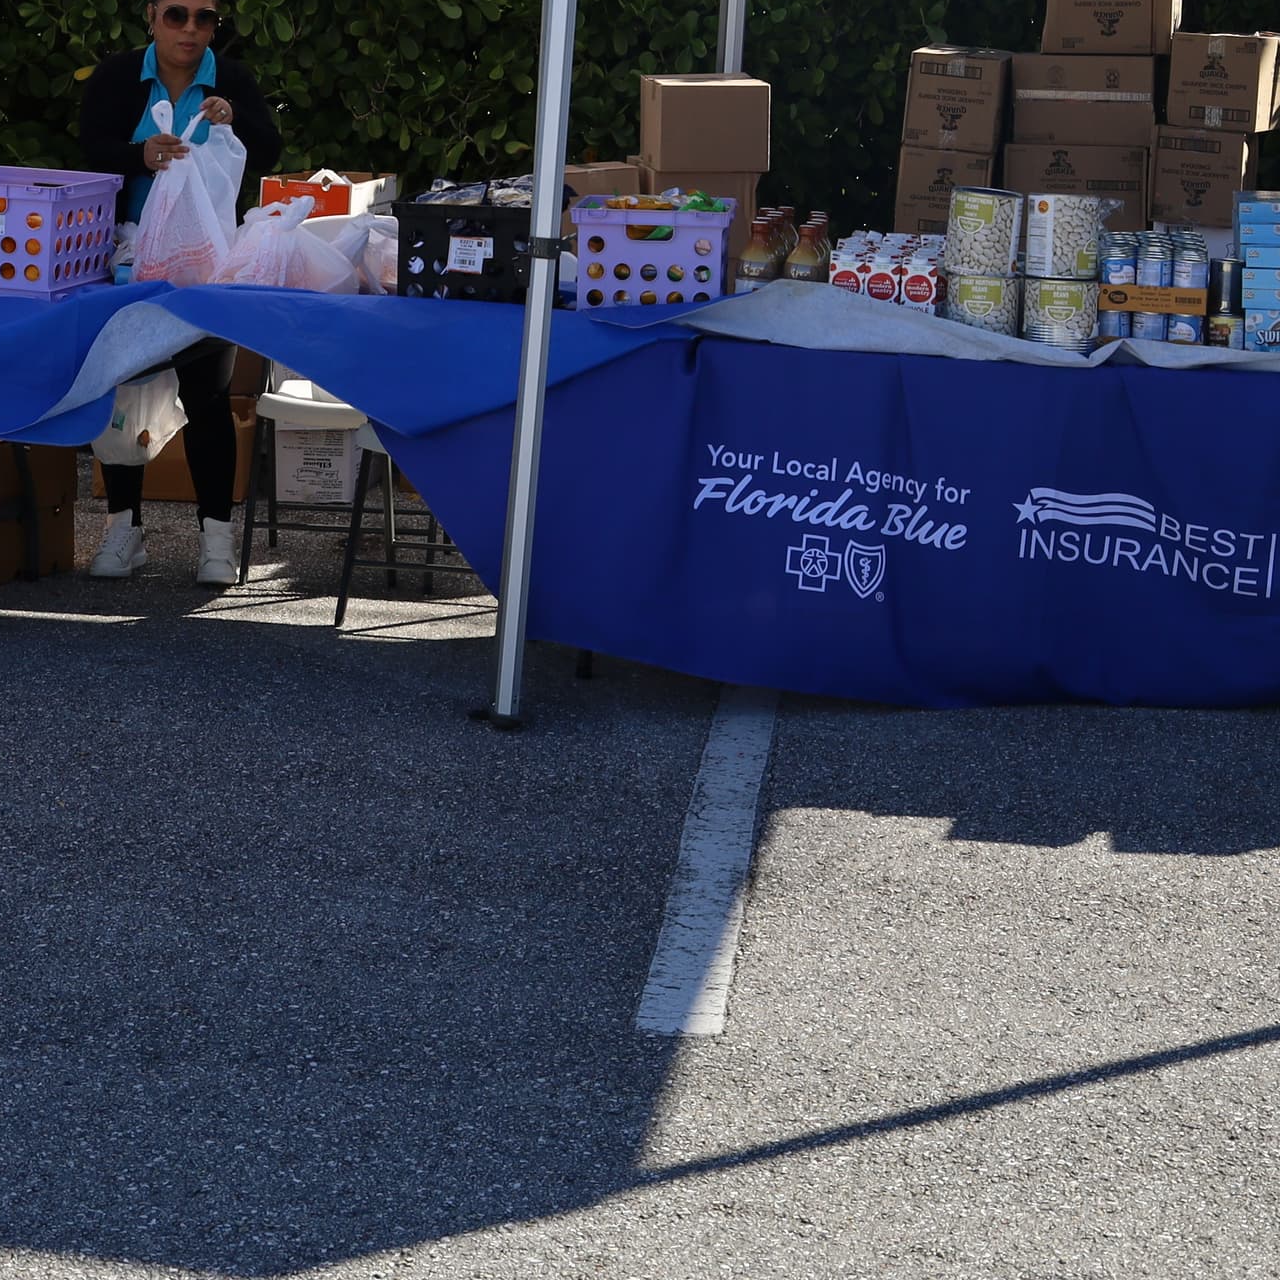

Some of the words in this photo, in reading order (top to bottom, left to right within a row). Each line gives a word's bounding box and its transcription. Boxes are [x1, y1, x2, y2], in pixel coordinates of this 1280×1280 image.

[707, 444, 765, 470] Your
[772, 451, 837, 483] Local
[845, 461, 928, 503] Agency
[934, 477, 971, 505] for
[693, 474, 877, 531] Florida
[881, 503, 967, 550] Blue
[1160, 513, 1265, 560] BEST
[1019, 527, 1261, 597] INSURANCE
